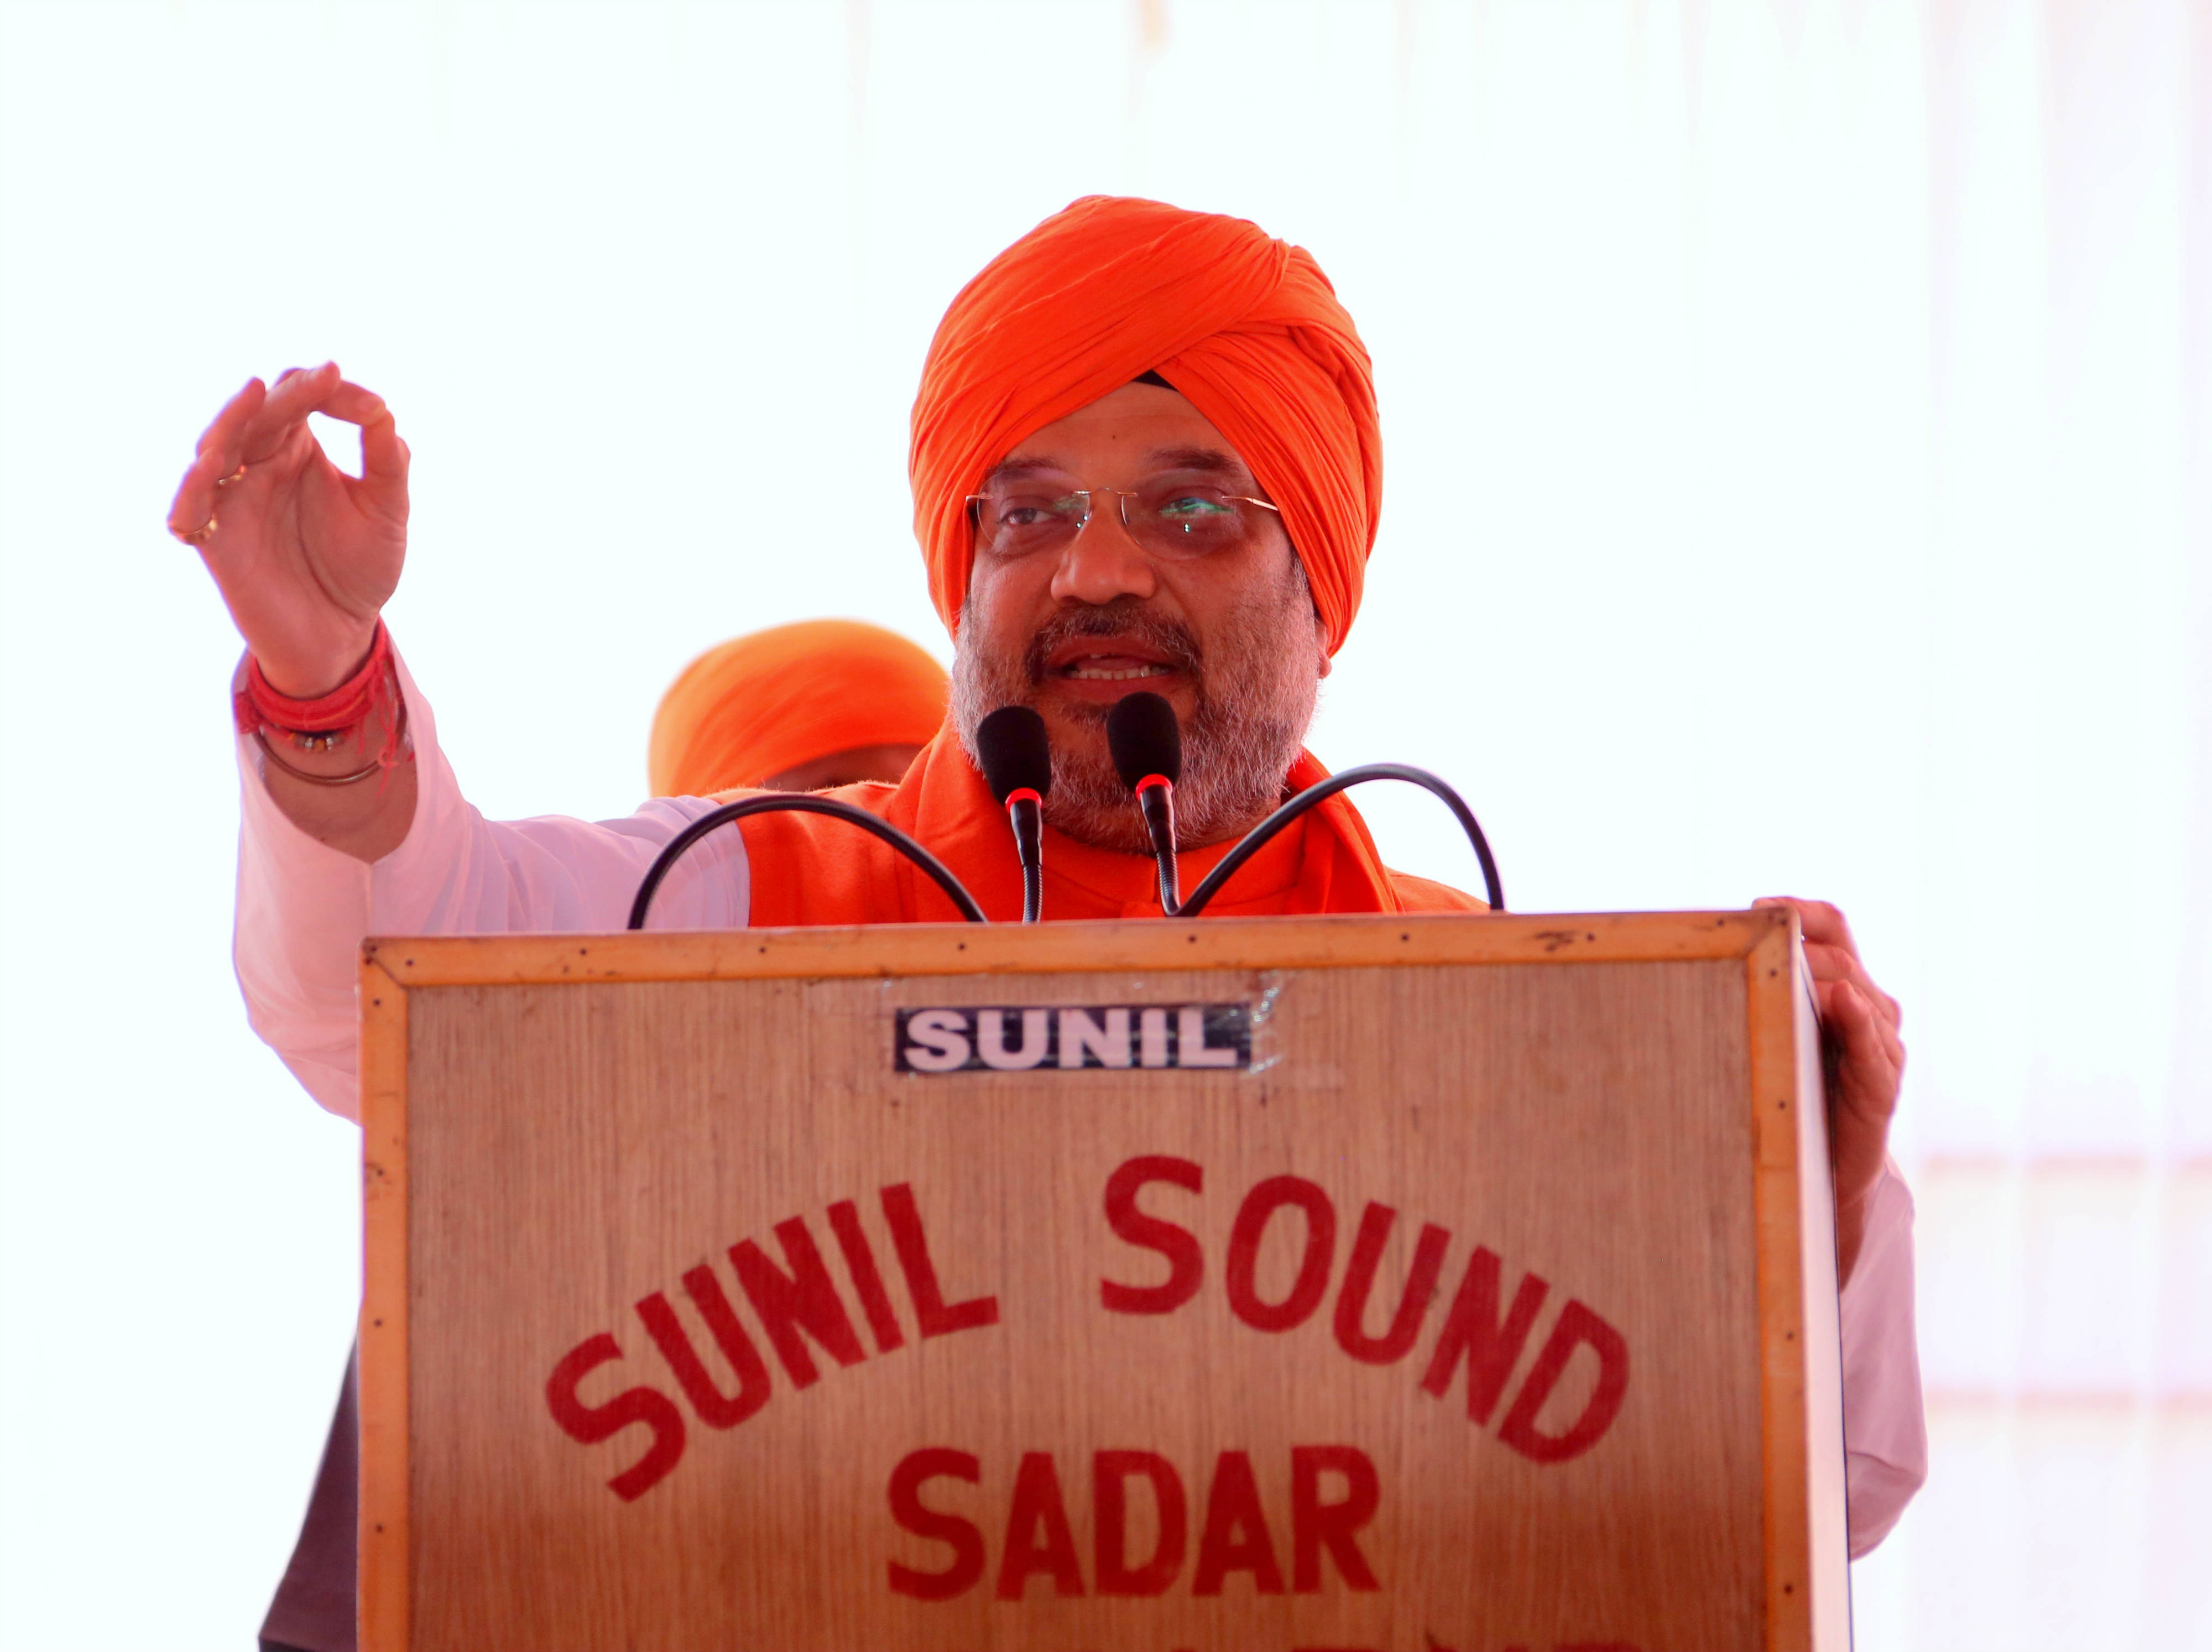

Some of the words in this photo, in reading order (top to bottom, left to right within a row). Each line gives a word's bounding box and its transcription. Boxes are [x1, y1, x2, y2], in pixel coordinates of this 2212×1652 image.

[903, 1008, 1238, 1071] SUNIL
[545, 1182, 1000, 1504] SUNIL
[1100, 1154, 1630, 1465] SOUND
[886, 1445, 1381, 1603] SADAR
